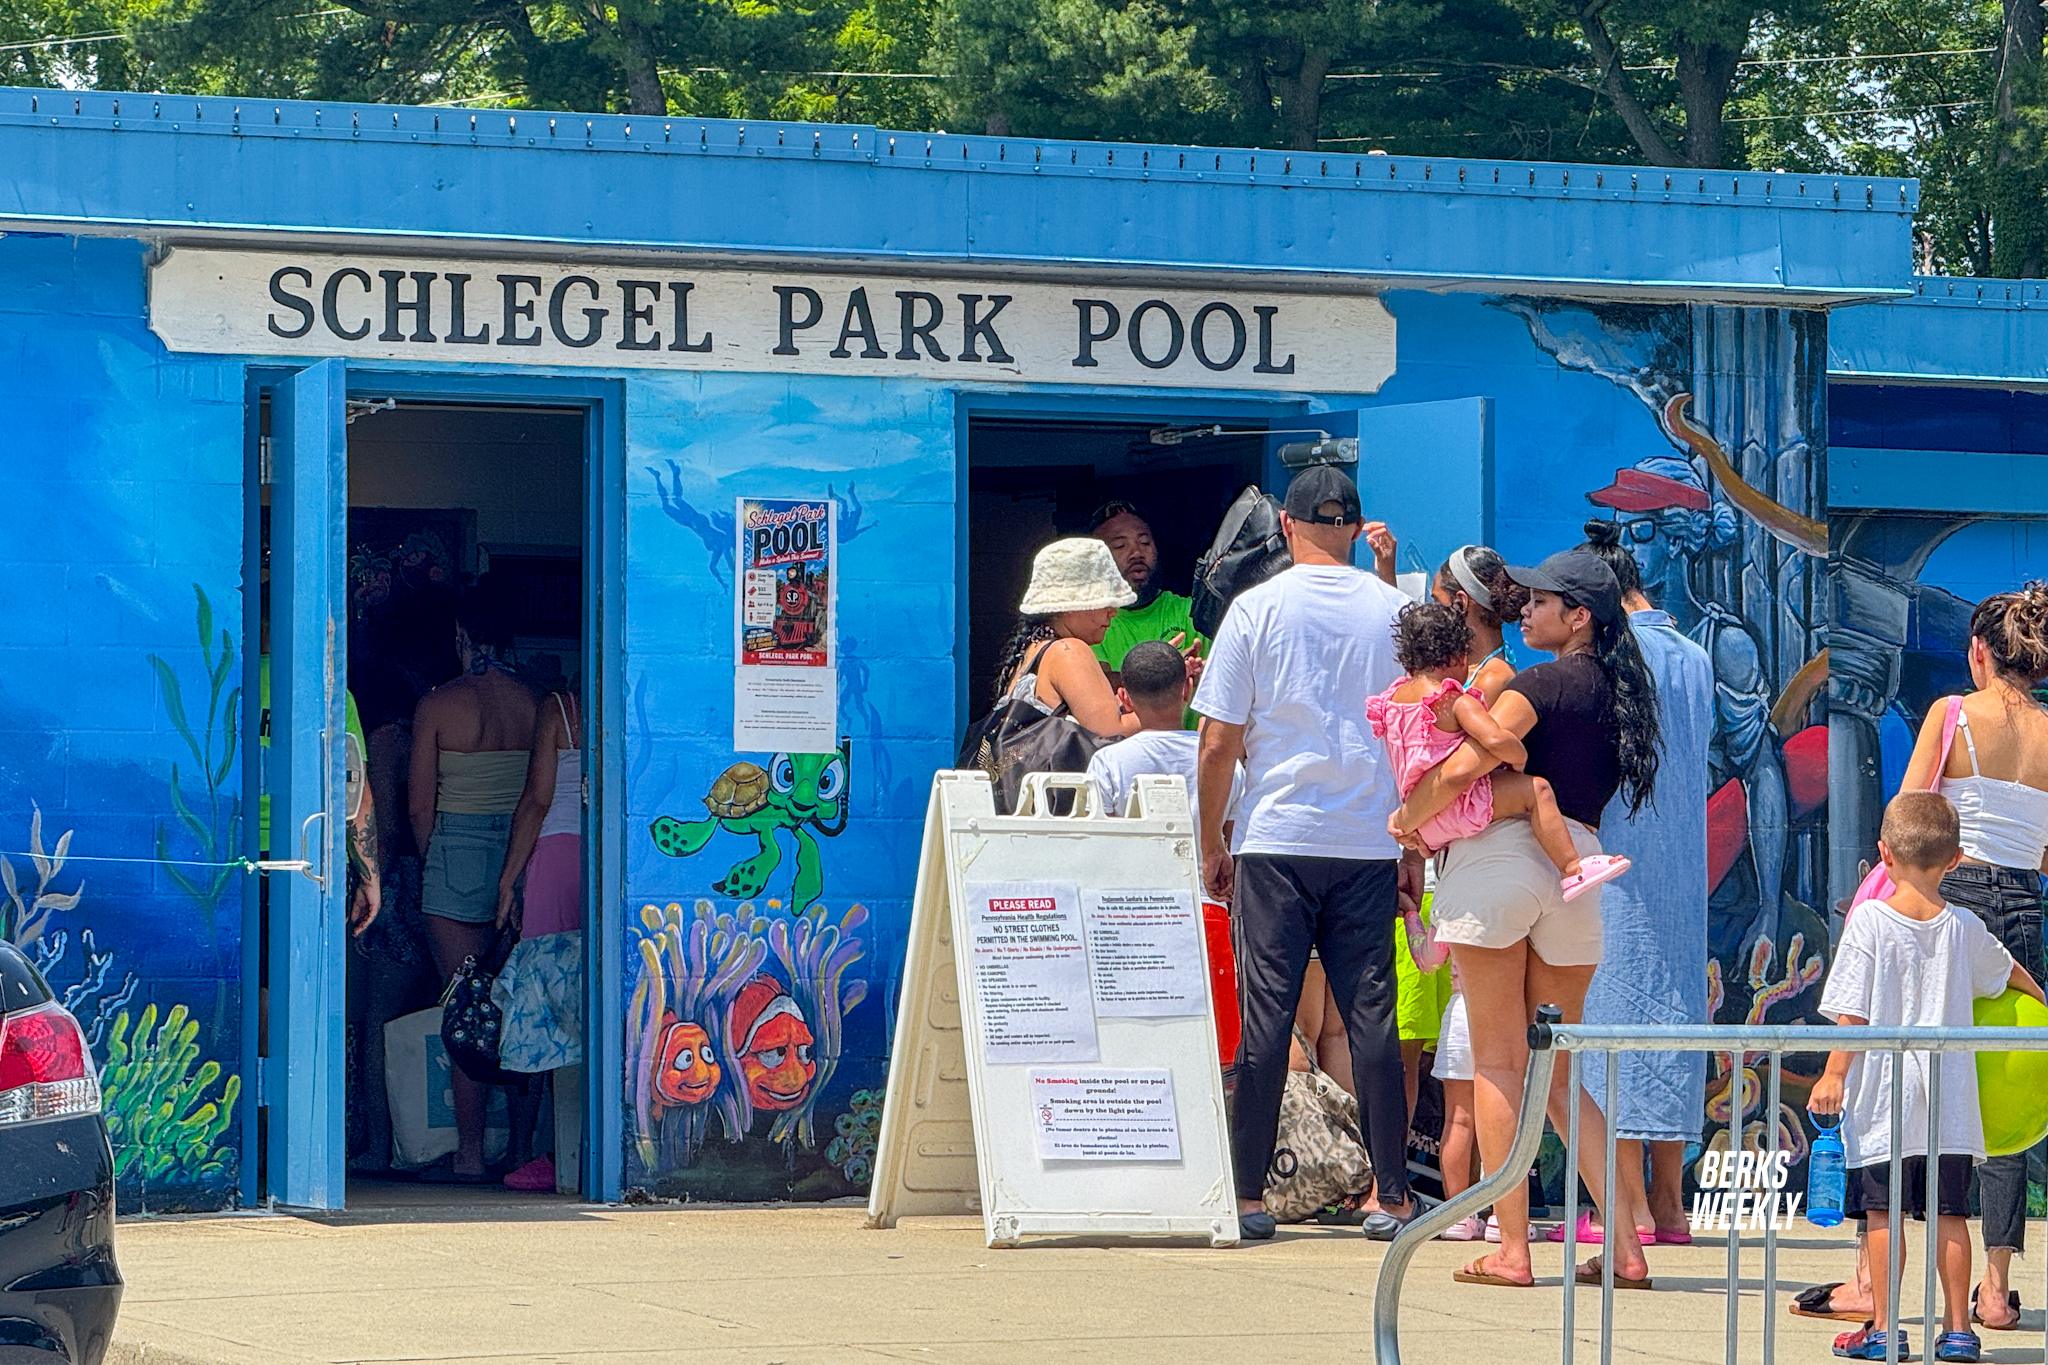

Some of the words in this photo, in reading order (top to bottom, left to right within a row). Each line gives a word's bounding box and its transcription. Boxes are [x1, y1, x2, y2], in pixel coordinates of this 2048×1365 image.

[268, 266, 712, 352] SCHLEGEL
[772, 285, 1015, 363] PARK
[1071, 299, 1295, 375] POOL
[747, 507, 796, 530] Schlegel
[798, 504, 825, 520] Park
[753, 521, 824, 564] POOL
[994, 900, 1026, 910] PLEASE
[1028, 900, 1051, 909] READ
[1005, 925, 1028, 933] STREET
[1031, 924, 1060, 932] CLOTHES
